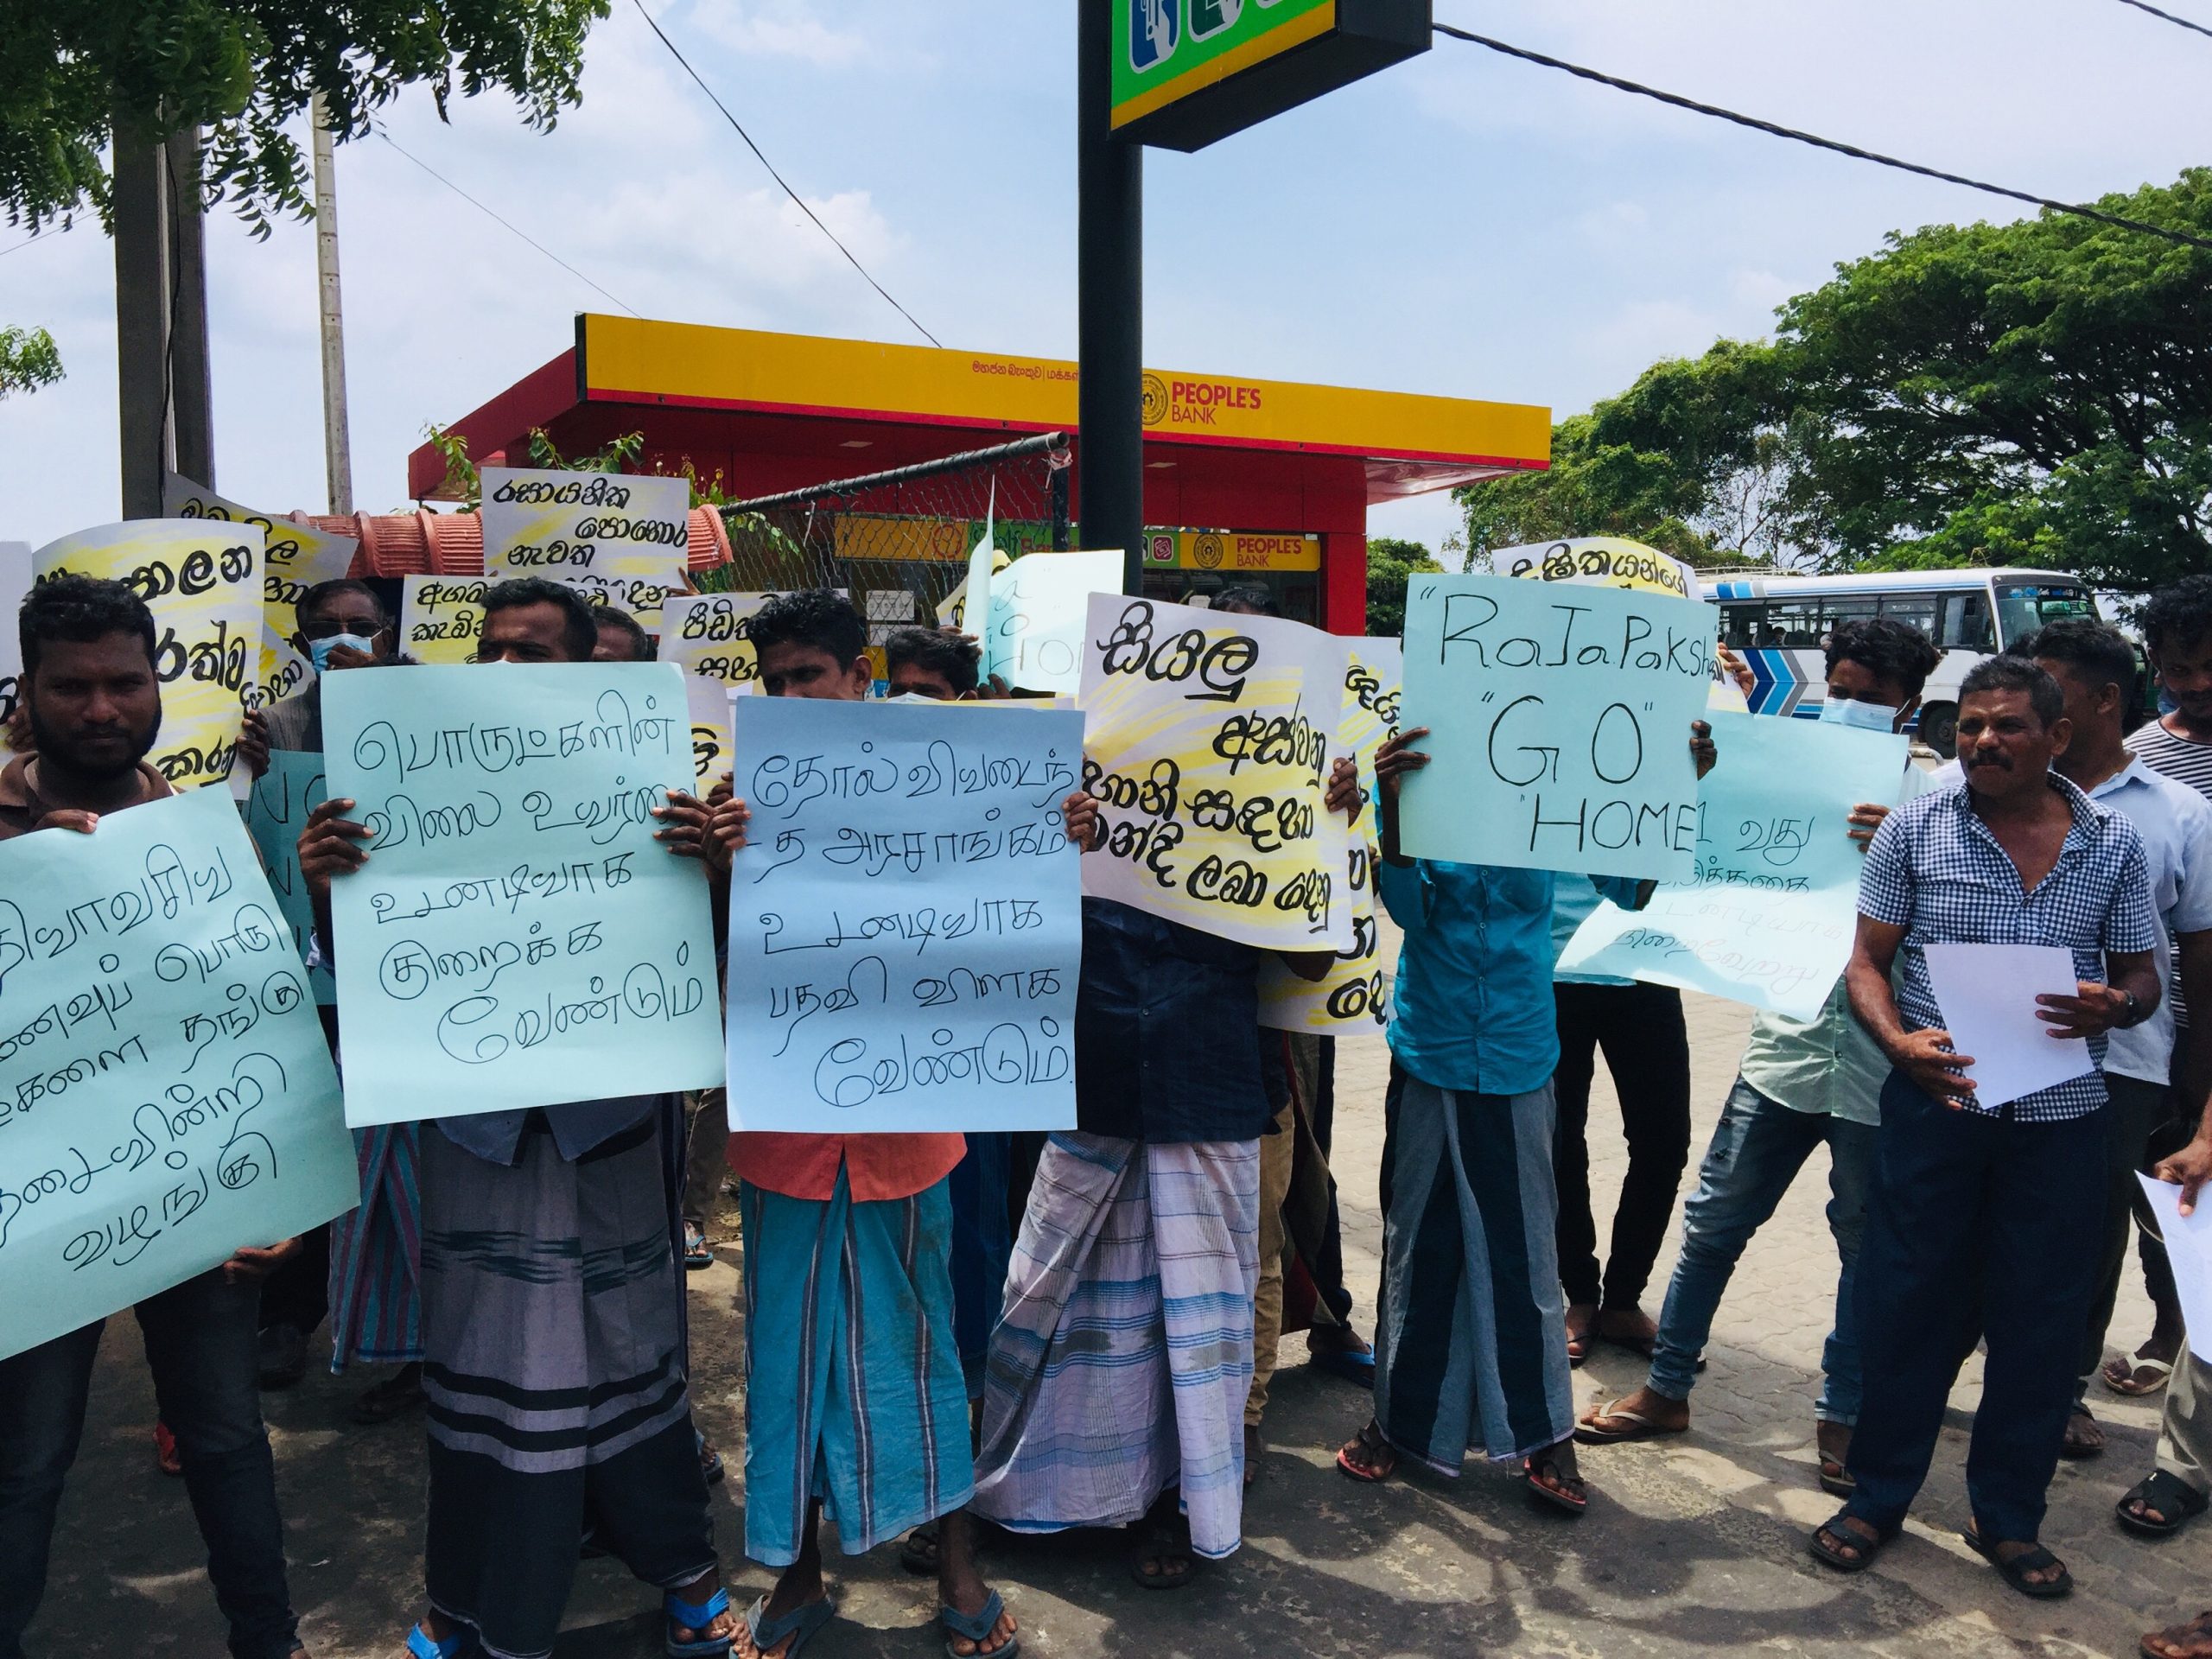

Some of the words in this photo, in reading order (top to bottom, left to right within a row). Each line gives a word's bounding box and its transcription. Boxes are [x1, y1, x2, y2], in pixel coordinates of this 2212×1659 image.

[972, 360, 1007, 375] මහජන
[1007, 363, 1042, 381] බැංකුව
[1172, 381, 1262, 410] PEOPLE'S
[1172, 404, 1217, 425] BANK
[1236, 537, 1302, 555] PEOPLE'S
[1236, 554, 1269, 568] BANK
[1096, 601, 1259, 703] සියලු
[364, 791, 502, 851] விலை
[822, 807, 1067, 877] அரசாங்கம்
[1736, 816, 1815, 866] வது
[379, 920, 602, 1000] குறைக்க
[436, 940, 703, 1064] வேண்டும்
[771, 956, 887, 1057] பதவி
